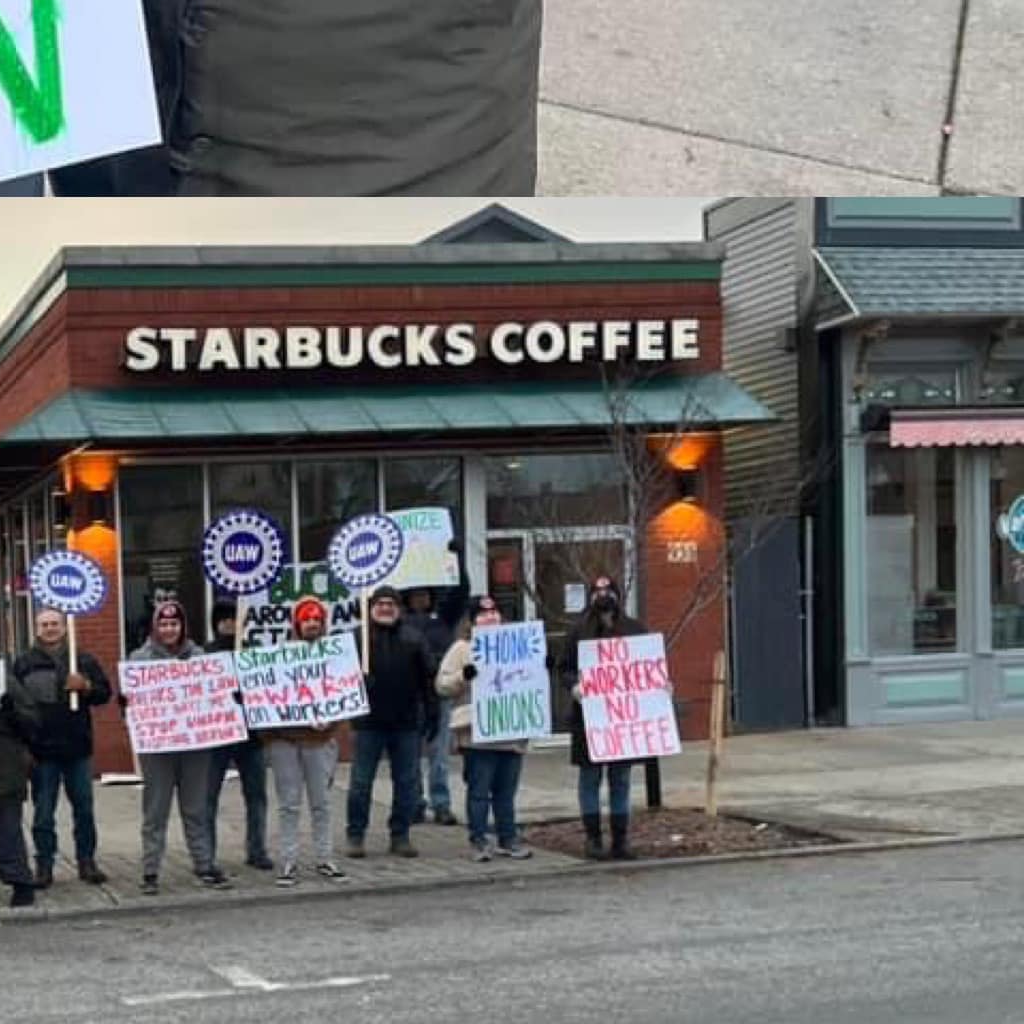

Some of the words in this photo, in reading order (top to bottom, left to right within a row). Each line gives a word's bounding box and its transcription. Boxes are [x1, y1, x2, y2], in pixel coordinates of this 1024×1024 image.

[126, 323, 475, 372] STARBUCKS
[491, 319, 700, 363] COFFEE
[226, 543, 261, 563] UAW
[238, 638, 344, 671] Starbucks
[596, 637, 630, 663] NO
[125, 659, 224, 688] STARBUCKS
[242, 667, 276, 689] end
[284, 662, 328, 691] your
[580, 660, 669, 694] WORKERS
[248, 706, 269, 724] on
[476, 688, 545, 737] UNIONS
[605, 695, 640, 721] NO
[587, 718, 676, 758] COFFEE
